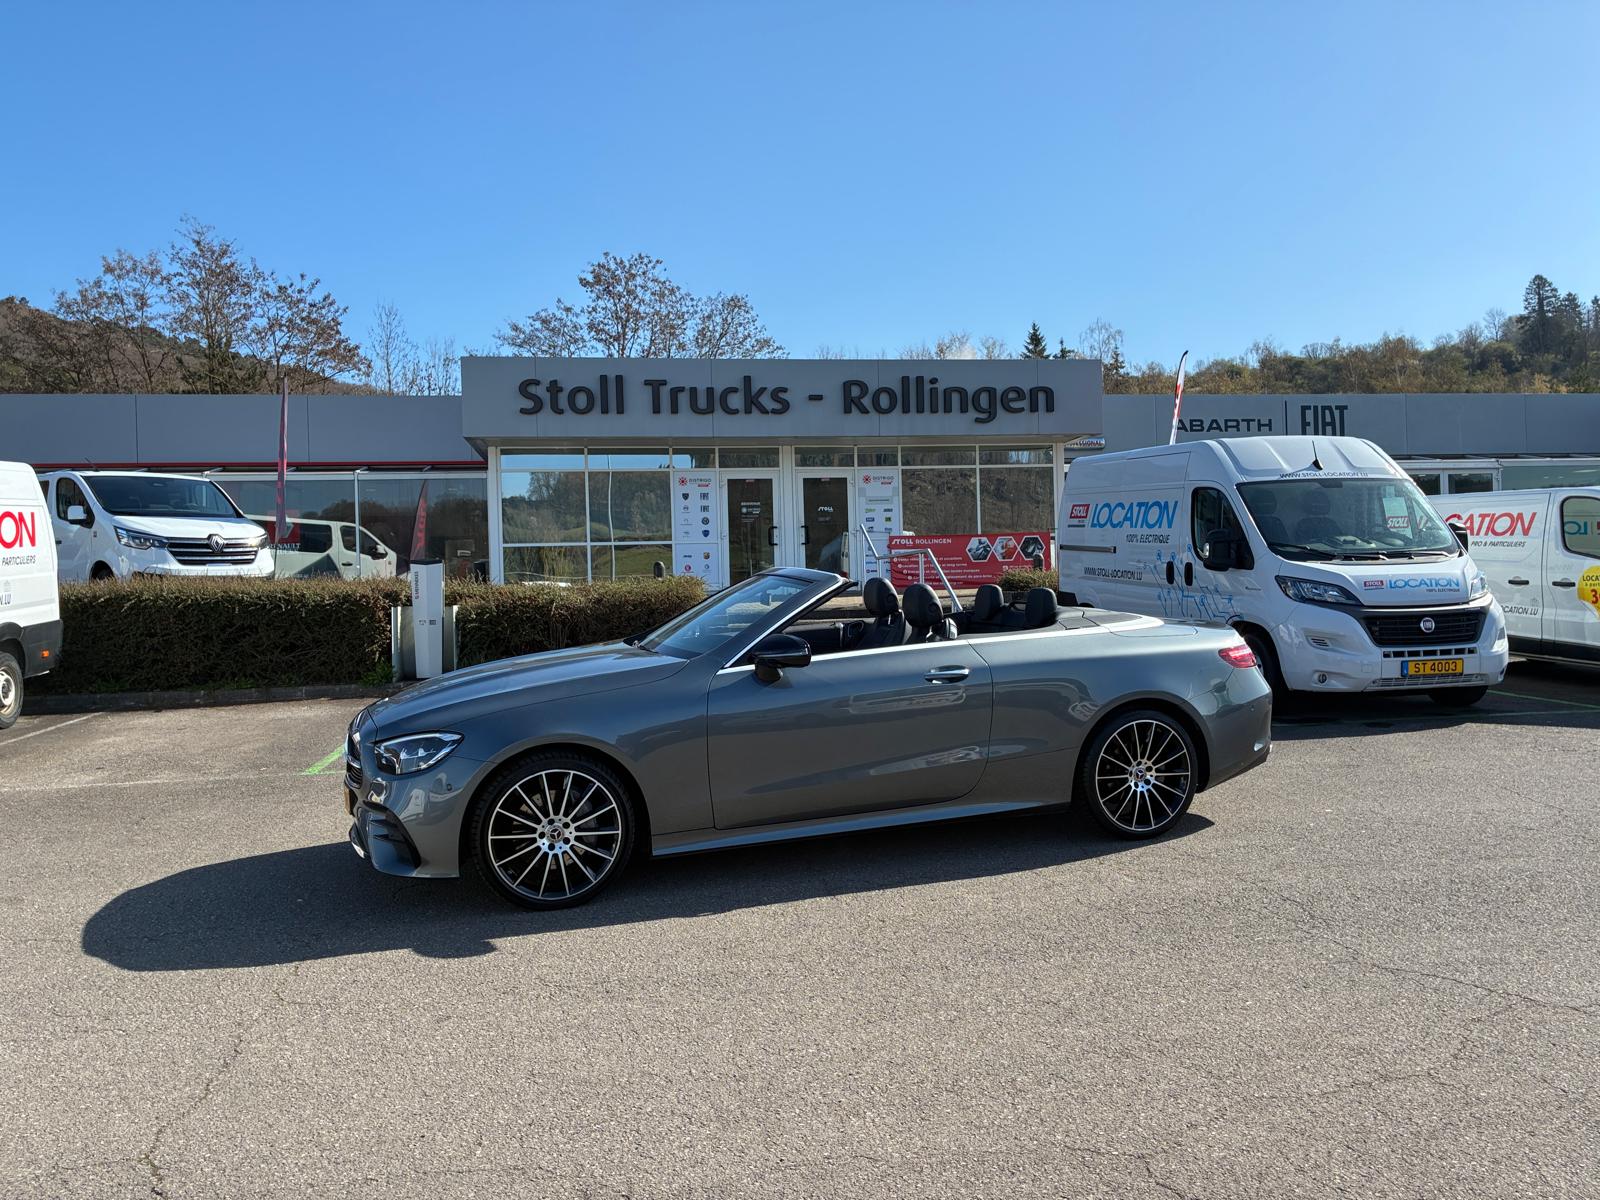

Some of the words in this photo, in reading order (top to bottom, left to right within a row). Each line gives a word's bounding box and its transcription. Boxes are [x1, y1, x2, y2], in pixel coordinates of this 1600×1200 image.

[518, 374, 625, 415] Stoll
[643, 375, 791, 415] Trucks
[842, 375, 1055, 424] Rollingen
[1176, 418, 1273, 433] ABARTH
[1300, 405, 1348, 436] FIAT
[1071, 505, 1089, 518] STOLL
[1090, 500, 1178, 529] LOCATION
[1387, 517, 1409, 528] STOLL
[1126, 533, 1139, 543] 100%
[1139, 534, 1170, 544] ELECTRIQUE
[1488, 540, 1527, 548] PARTICULIERS
[2, 555, 36, 566] PARTICULIERS
[1084, 566, 1143, 580] WWW.STOLL-LOCATION.LU
[1388, 578, 1460, 589] LOCATION
[1414, 662, 1428, 673] ST
[1430, 661, 1457, 672] 4003
